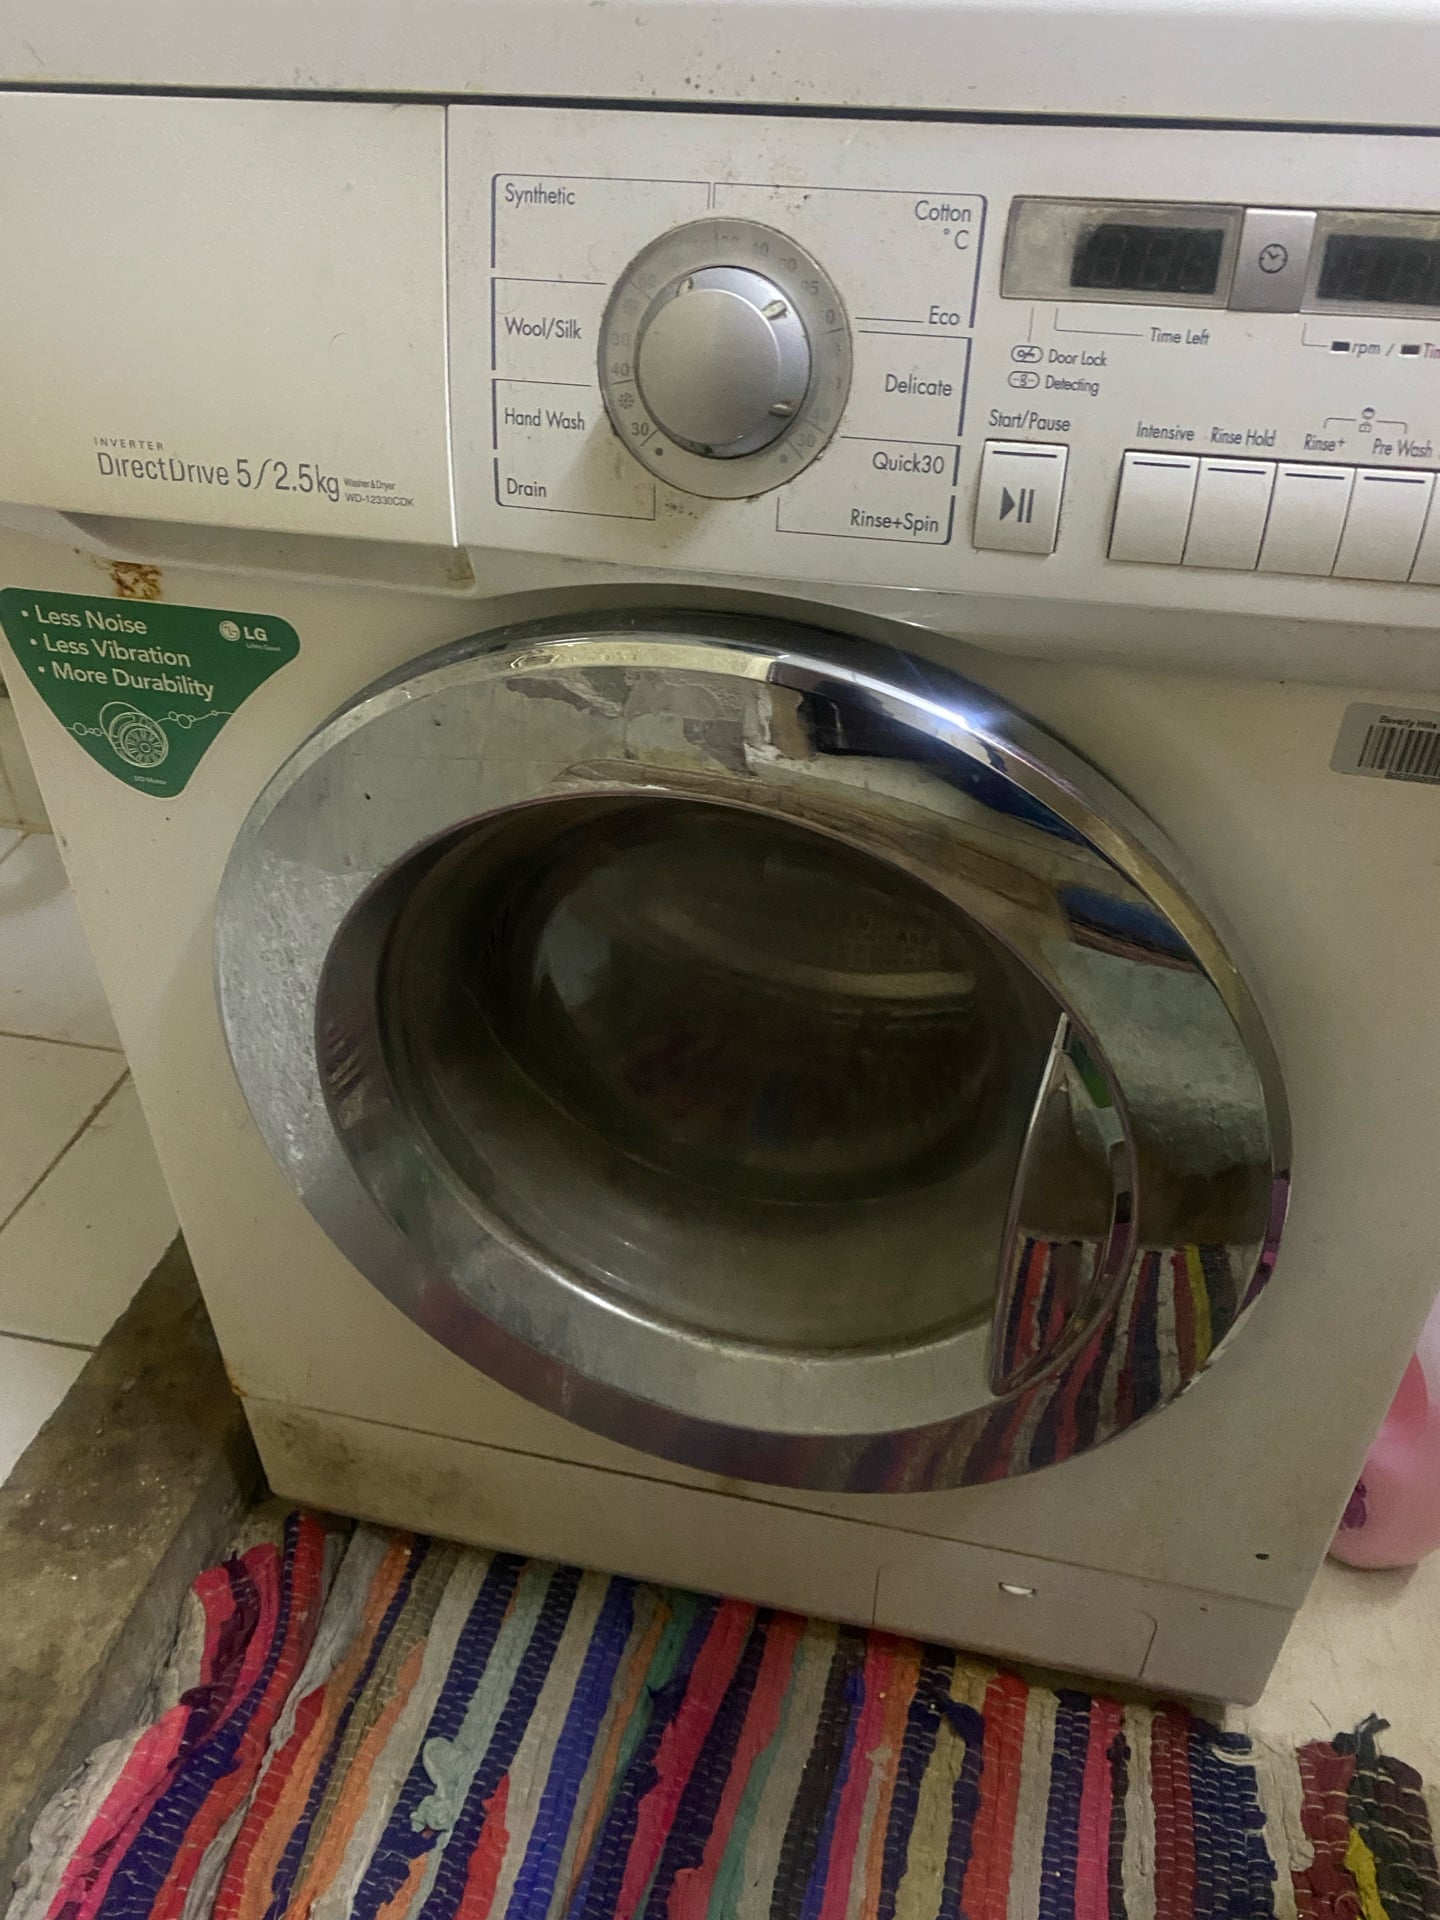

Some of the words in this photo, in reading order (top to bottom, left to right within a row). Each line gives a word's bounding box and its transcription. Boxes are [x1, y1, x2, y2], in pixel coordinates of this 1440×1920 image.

[504, 183, 576, 206] Synthetic
[914, 200, 972, 223] Cotton
[929, 307, 960, 326] Eco
[504, 316, 582, 340] Wool/Silk
[1151, 327, 1181, 343] Time
[1182, 328, 1210, 345] Left
[1048, 349, 1078, 365] Door
[1081, 351, 1107, 367] Lock
[1352, 343, 1380, 358] rpm
[885, 374, 953, 397] Delicate
[1045, 375, 1100, 397] Detecting
[504, 407, 542, 427] Hand
[545, 411, 585, 432] Wash
[631, 422, 649, 437] 30
[989, 409, 1071, 433] Start/Pause
[1136, 421, 1195, 442] Intensive
[1210, 426, 1242, 445] Rinse
[1245, 429, 1276, 448] Hold
[94, 436, 165, 450] INVERTER
[1372, 438, 1393, 455] Pre
[1398, 440, 1432, 458] Wash
[872, 451, 944, 476] Quick30
[506, 478, 547, 499] Drain
[850, 509, 939, 534] Rinse+Spin
[35, 604, 82, 629] Less
[87, 611, 148, 636] Noise
[243, 626, 268, 642] LG
[43, 633, 90, 657] Less
[95, 640, 191, 668] Vibration
[52, 661, 108, 686] More
[112, 668, 215, 702] Durability
